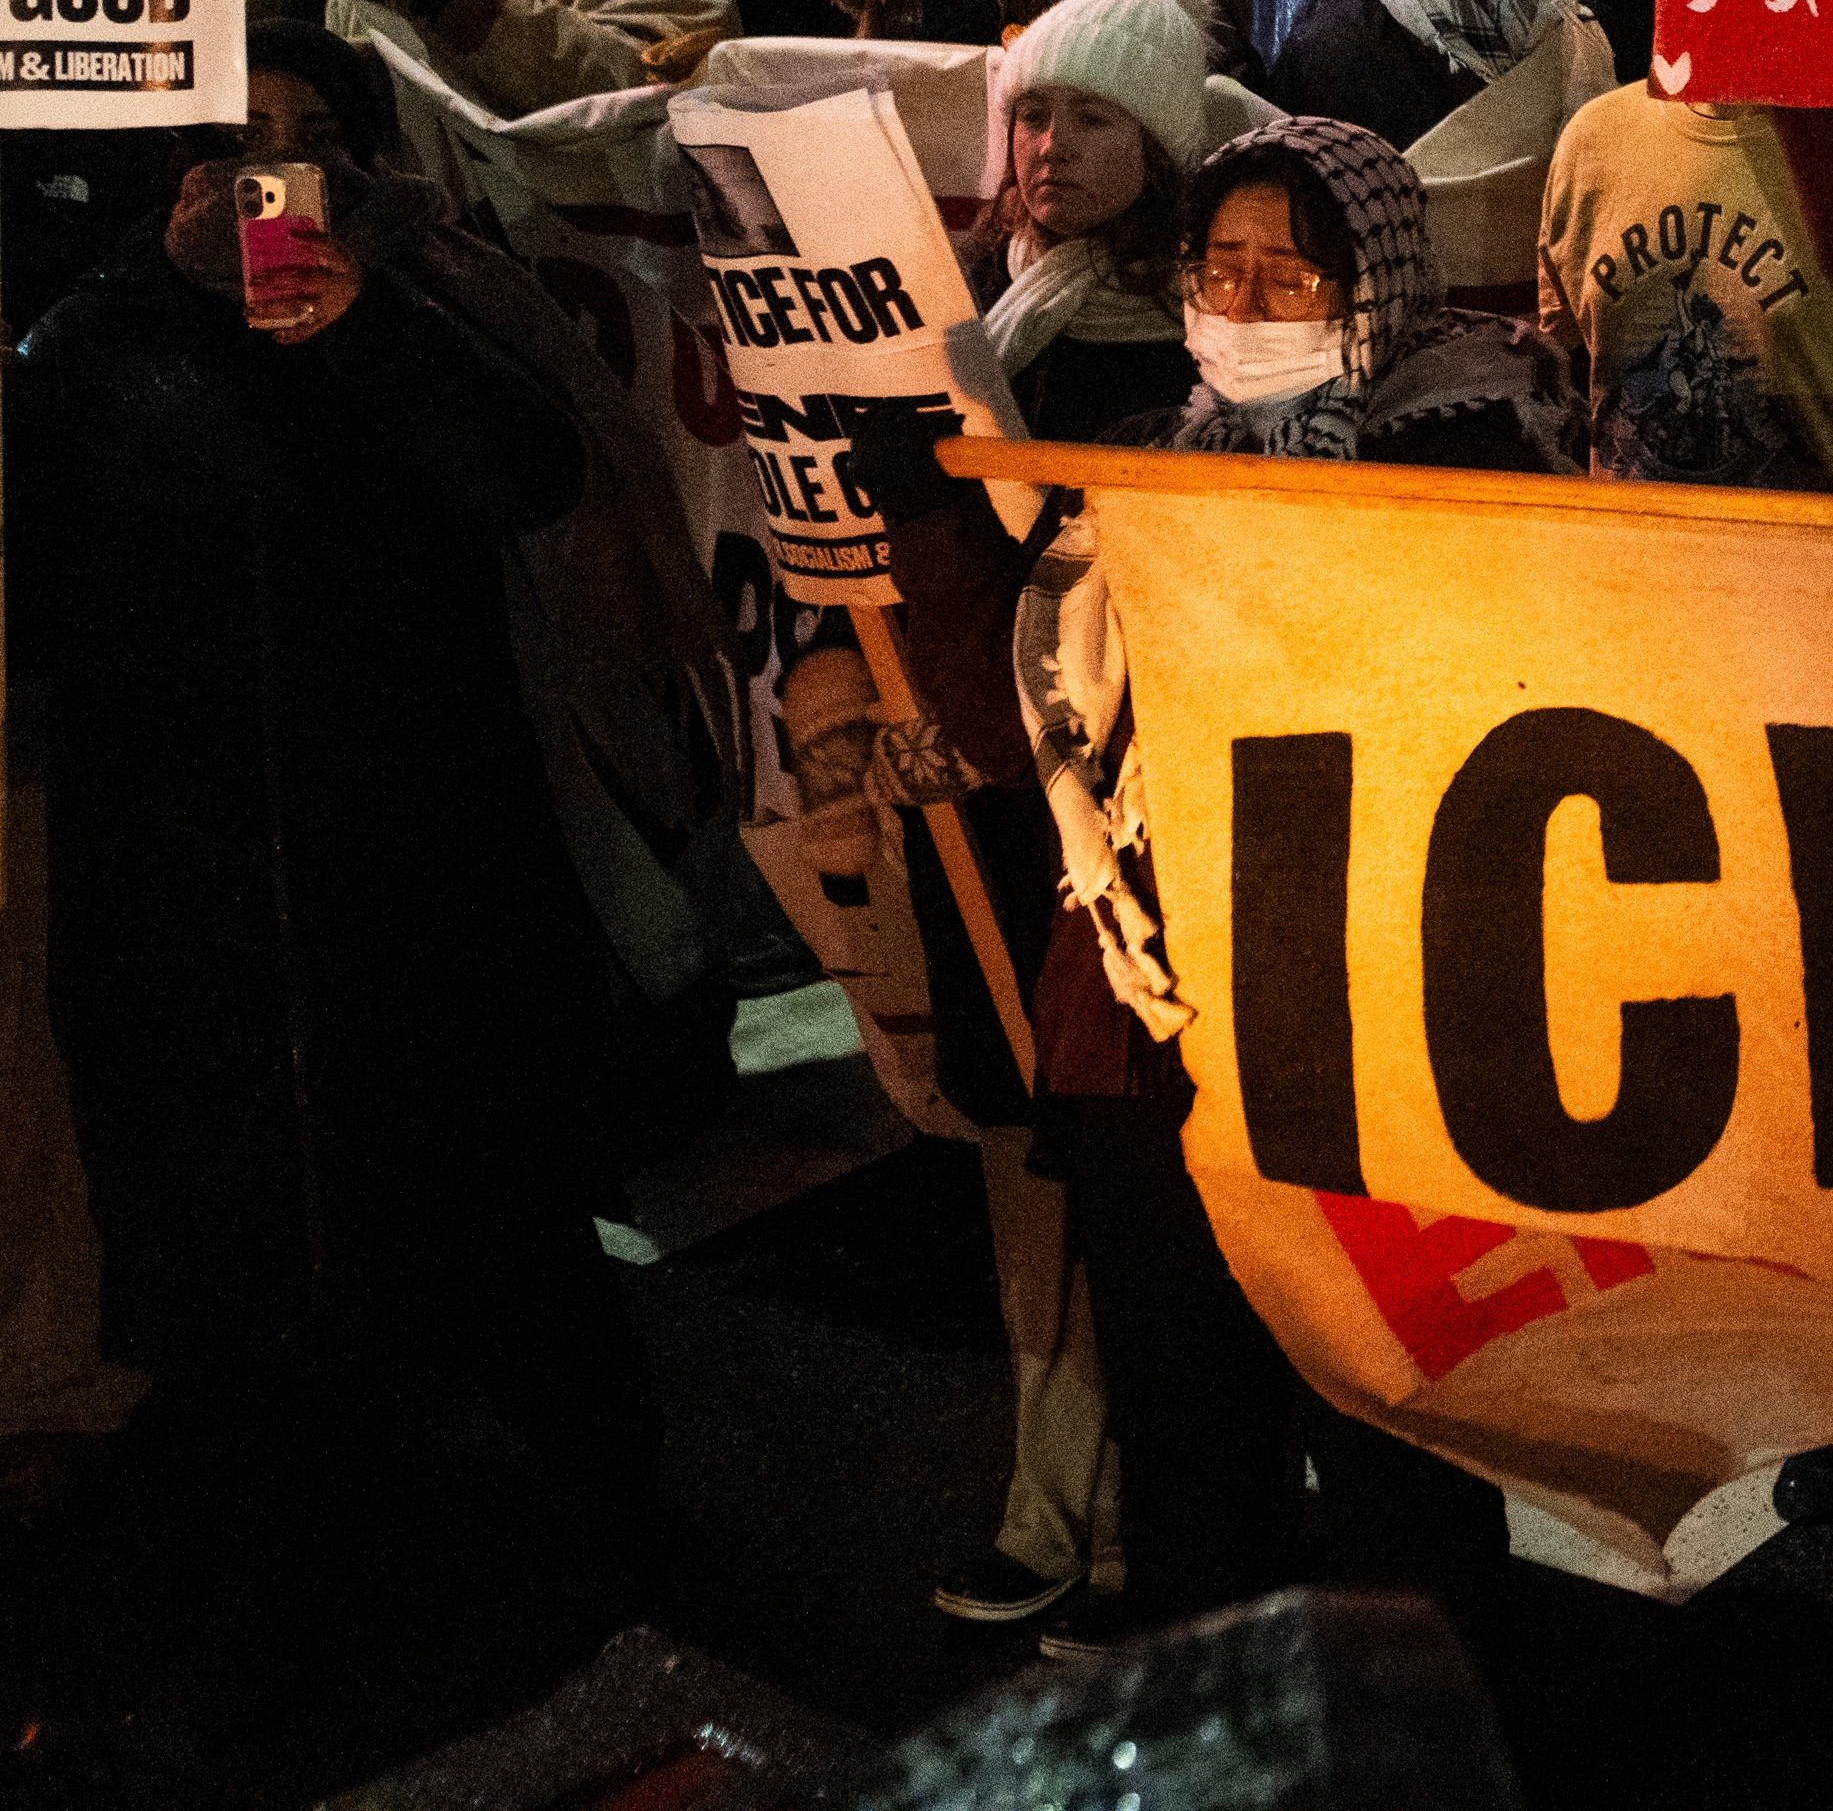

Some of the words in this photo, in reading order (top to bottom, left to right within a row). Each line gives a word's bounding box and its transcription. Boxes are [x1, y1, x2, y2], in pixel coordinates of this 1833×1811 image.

[18, 50, 50, 83] &
[53, 51, 186, 83] LIBERATION
[786, 256, 926, 346] FOR
[1589, 200, 1811, 314] PROTECT
